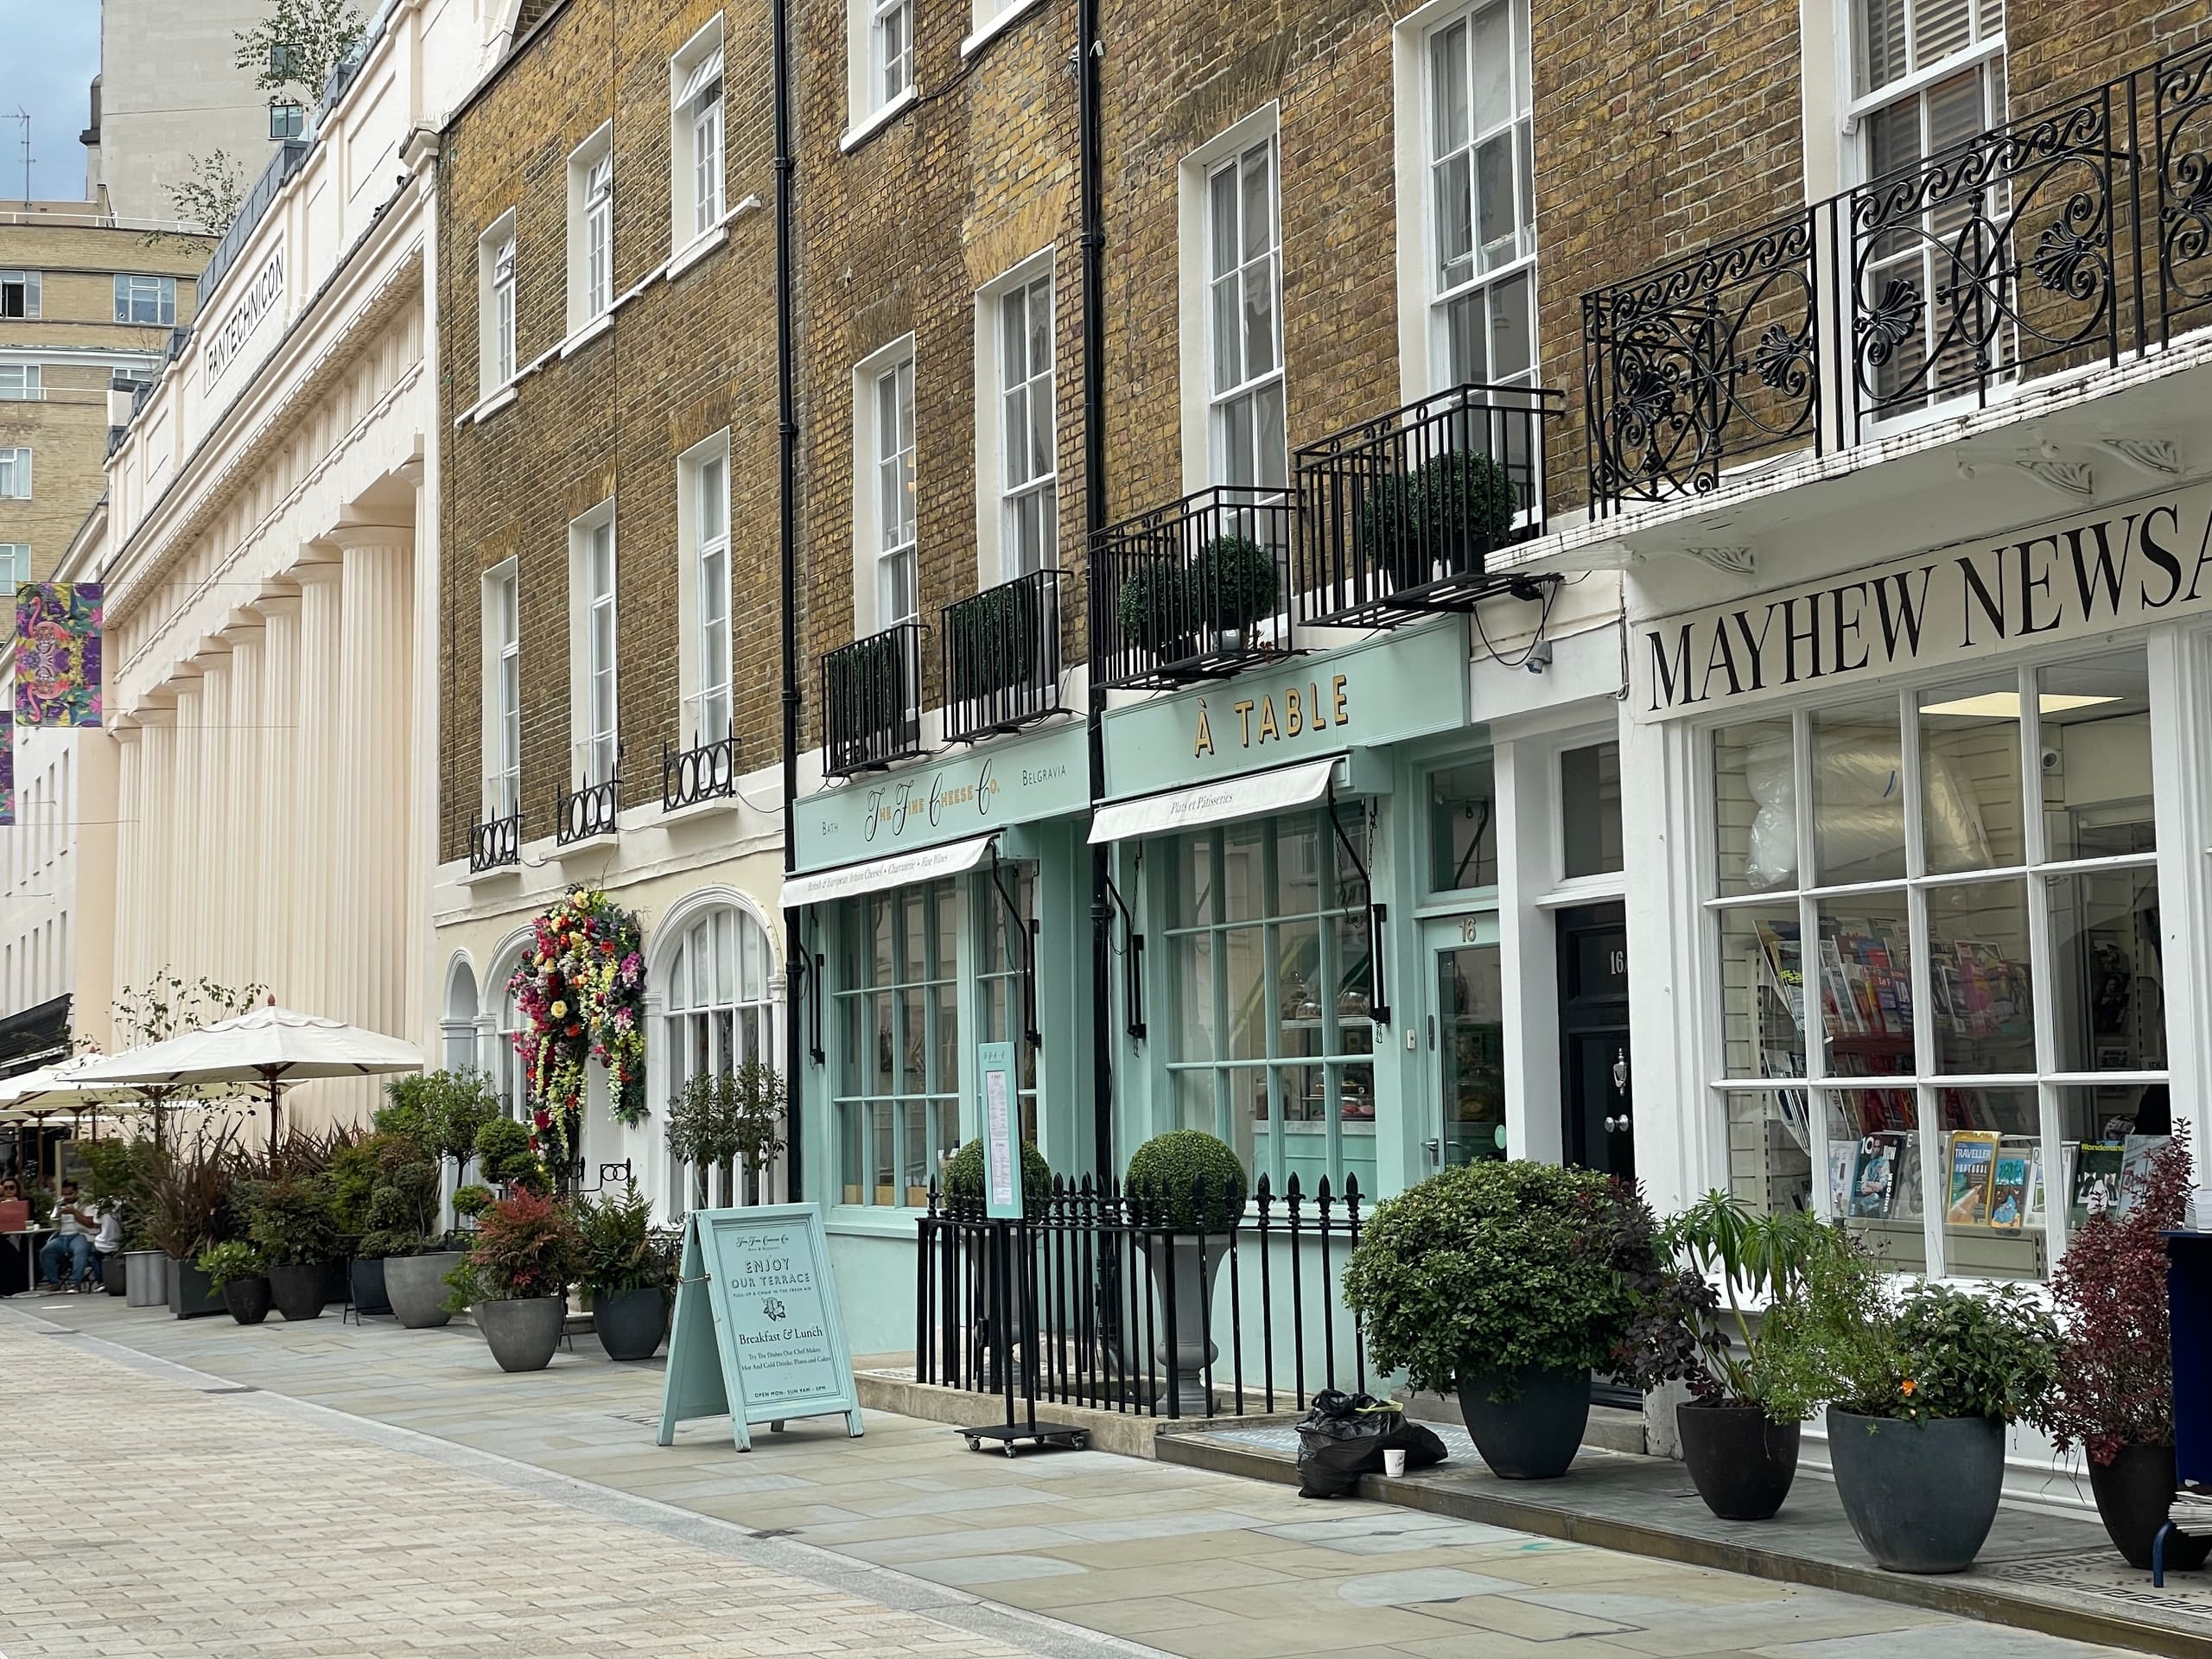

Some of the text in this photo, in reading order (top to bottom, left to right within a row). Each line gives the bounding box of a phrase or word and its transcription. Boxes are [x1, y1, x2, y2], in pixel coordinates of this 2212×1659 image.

[207, 245, 283, 386] PANTECHNICON
[1646, 564, 1937, 712] MAYHEW
[1195, 674, 1349, 758] À TABLE
[865, 787, 892, 842] THE
[893, 779, 925, 836] FINE
[929, 772, 974, 827] CHEESE
[1022, 765, 1066, 786] BELGRAVIA
[1459, 916, 1477, 942] 16
[1610, 950, 1627, 975] 16
[1955, 1148, 1992, 1160] TRAVELLER
[1955, 1164, 1987, 1173] PORTUGAL
[746, 1257, 789, 1274] ENJOY
[732, 1273, 810, 1288] OUR TERRACE
[740, 1325, 823, 1345] Breakfast & Lunch
